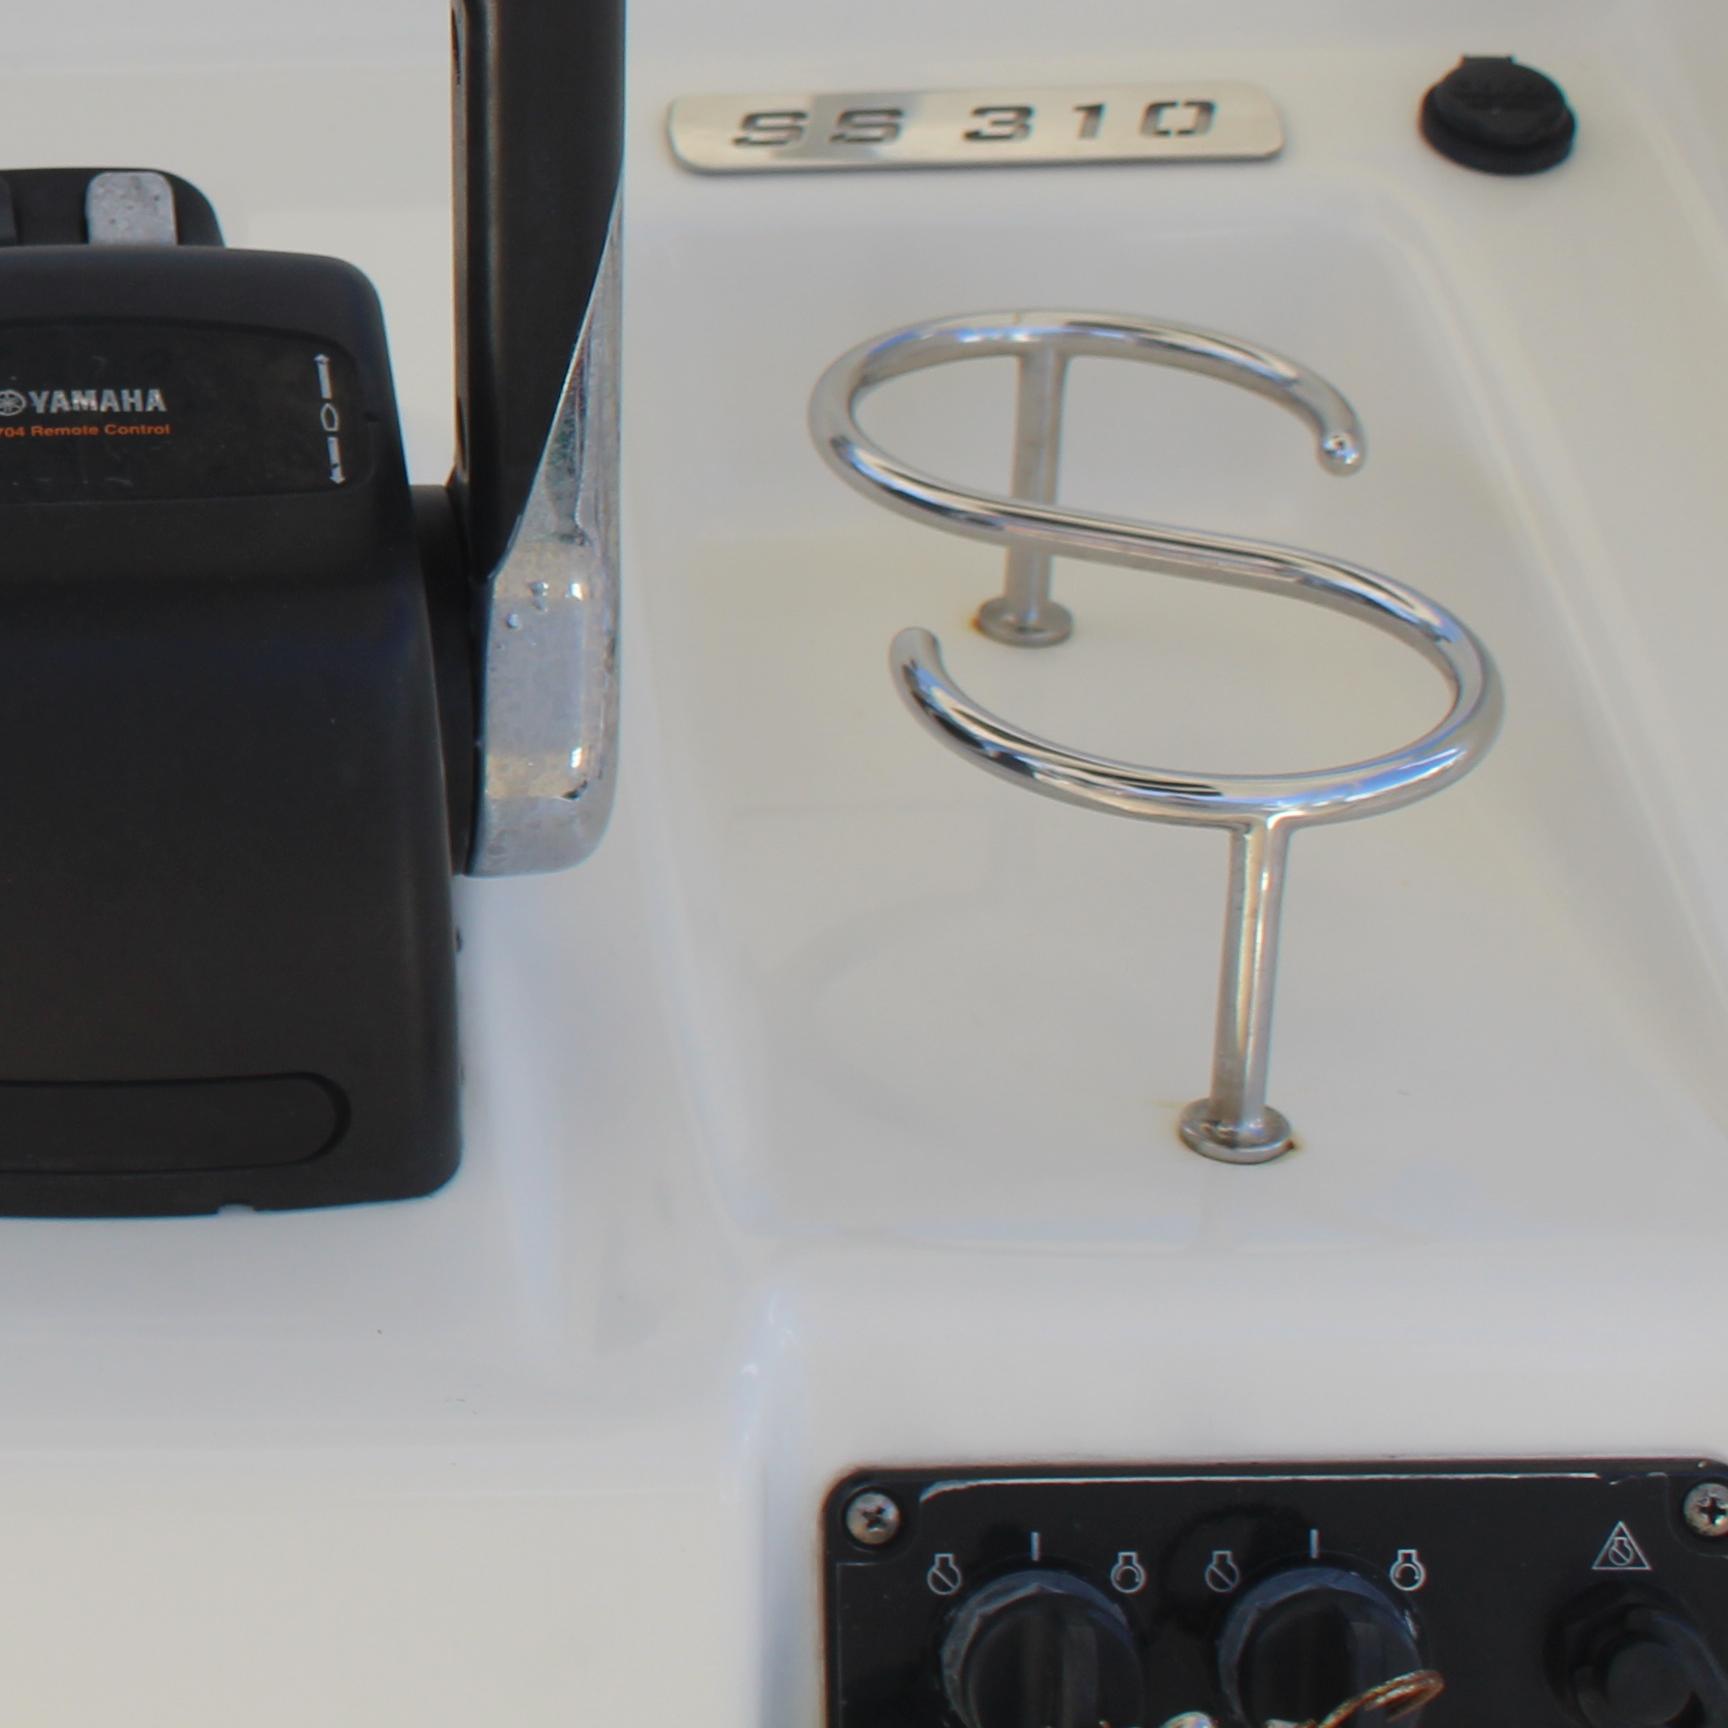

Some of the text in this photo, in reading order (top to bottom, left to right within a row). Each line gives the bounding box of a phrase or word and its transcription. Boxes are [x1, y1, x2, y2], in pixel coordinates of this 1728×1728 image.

[732, 100, 1216, 147] SS 310
[28, 389, 166, 414] YAMAHA
[31, 425, 99, 437] Remote
[104, 423, 171, 437] Control
